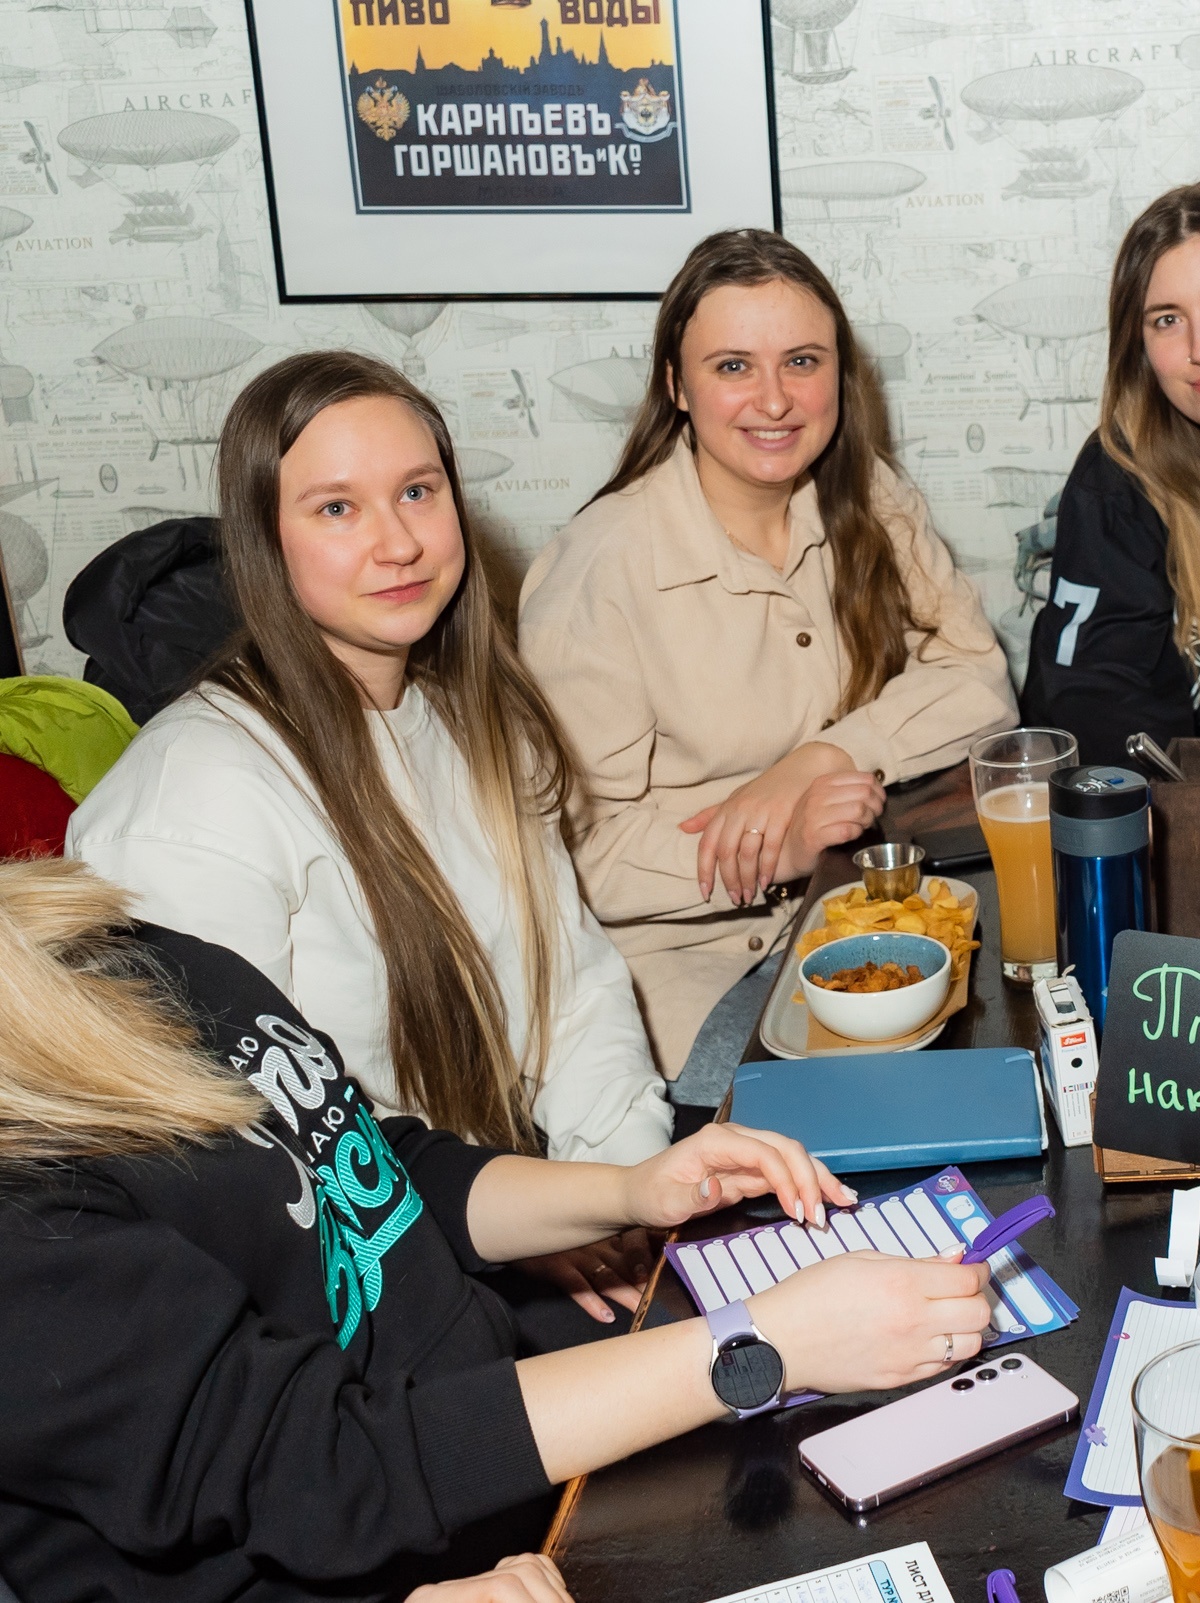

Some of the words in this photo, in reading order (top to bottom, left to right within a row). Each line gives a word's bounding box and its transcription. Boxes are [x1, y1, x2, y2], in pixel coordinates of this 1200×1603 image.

[352, 0, 450, 26] ПИВО
[560, 0, 660, 27] ВОДЫ
[1030, 44, 1180, 67] AIRCRAFT
[123, 89, 252, 112] AIRCRAF
[394, 144, 595, 176] ГОРШАНОВЪ
[905, 193, 984, 209] AVIATION
[15, 237, 93, 251] AVIATION
[494, 477, 570, 493] AVIATION
[1053, 576, 1100, 666] 7
[880, 1579, 894, 1596] ТУР
[905, 1560, 927, 1587] ЛИСТ
[916, 1590, 937, 1603] ДЛ
